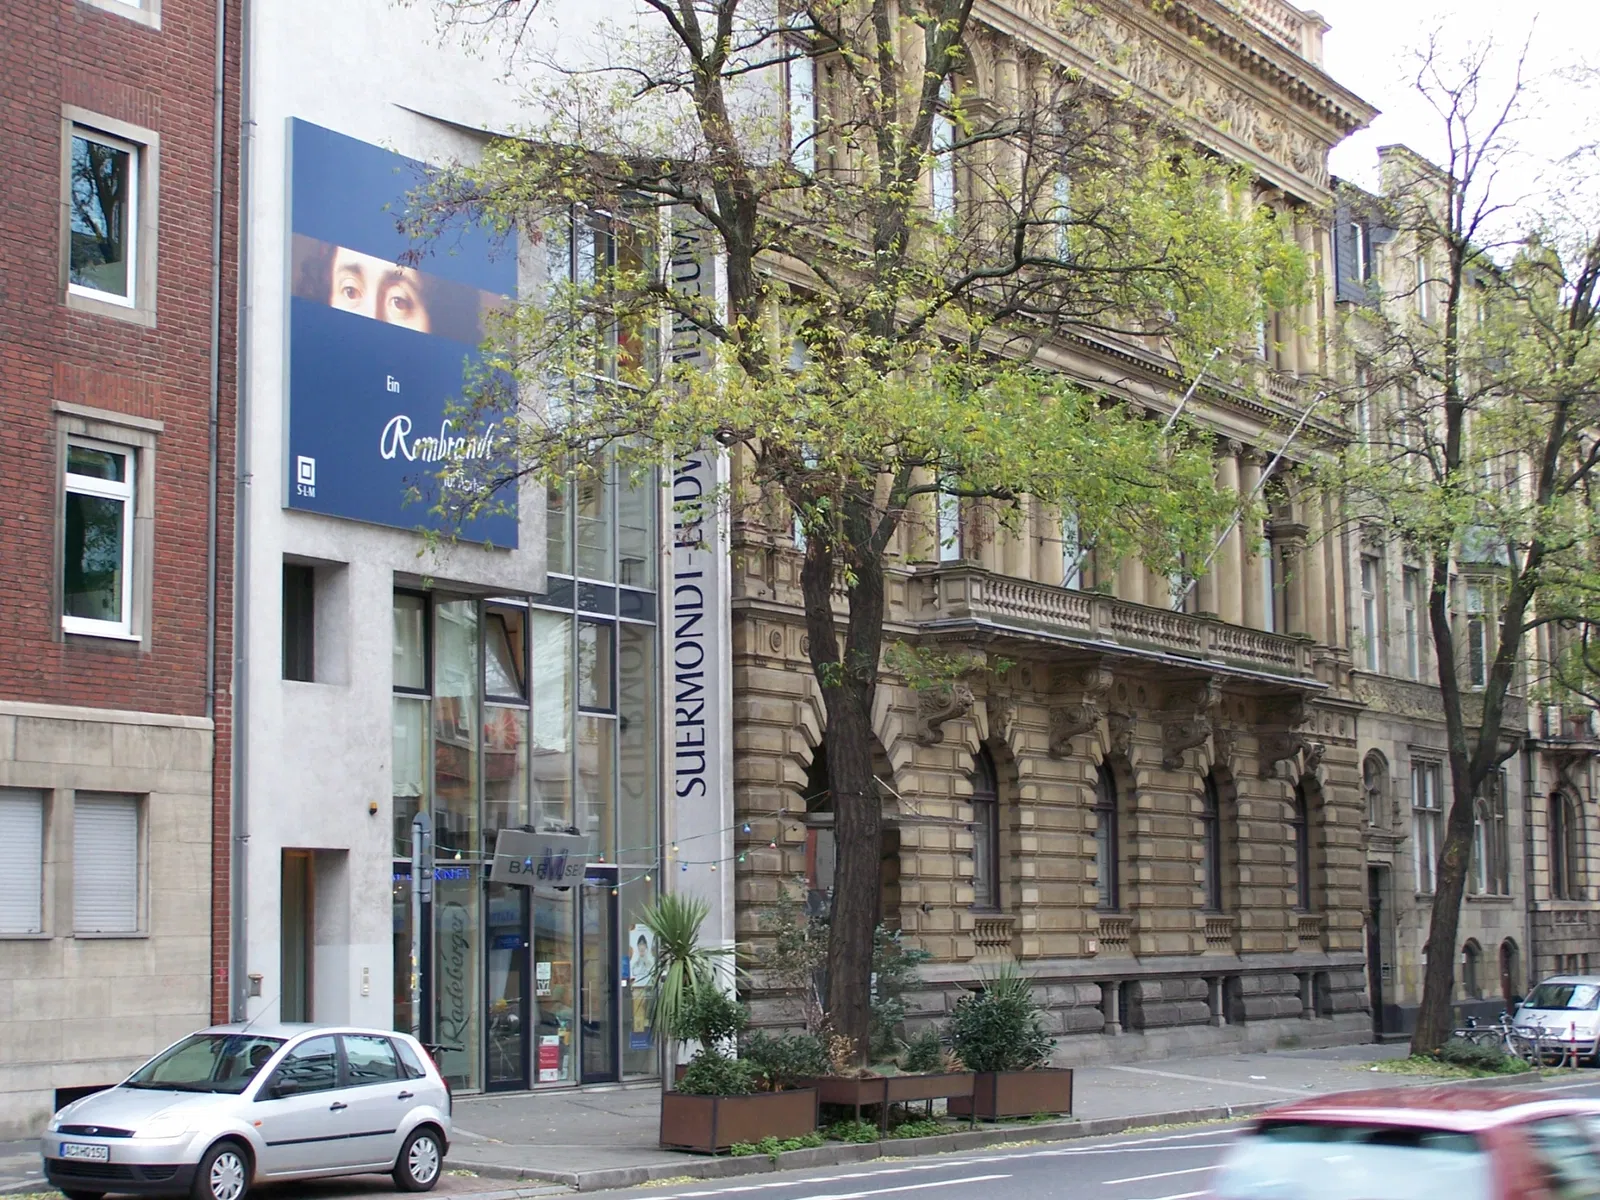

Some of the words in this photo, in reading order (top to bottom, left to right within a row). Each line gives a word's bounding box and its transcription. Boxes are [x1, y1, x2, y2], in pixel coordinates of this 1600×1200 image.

[386, 375, 400, 394] Ein
[381, 414, 495, 463] Rembrandt
[441, 911, 472, 1045] Radeberger
